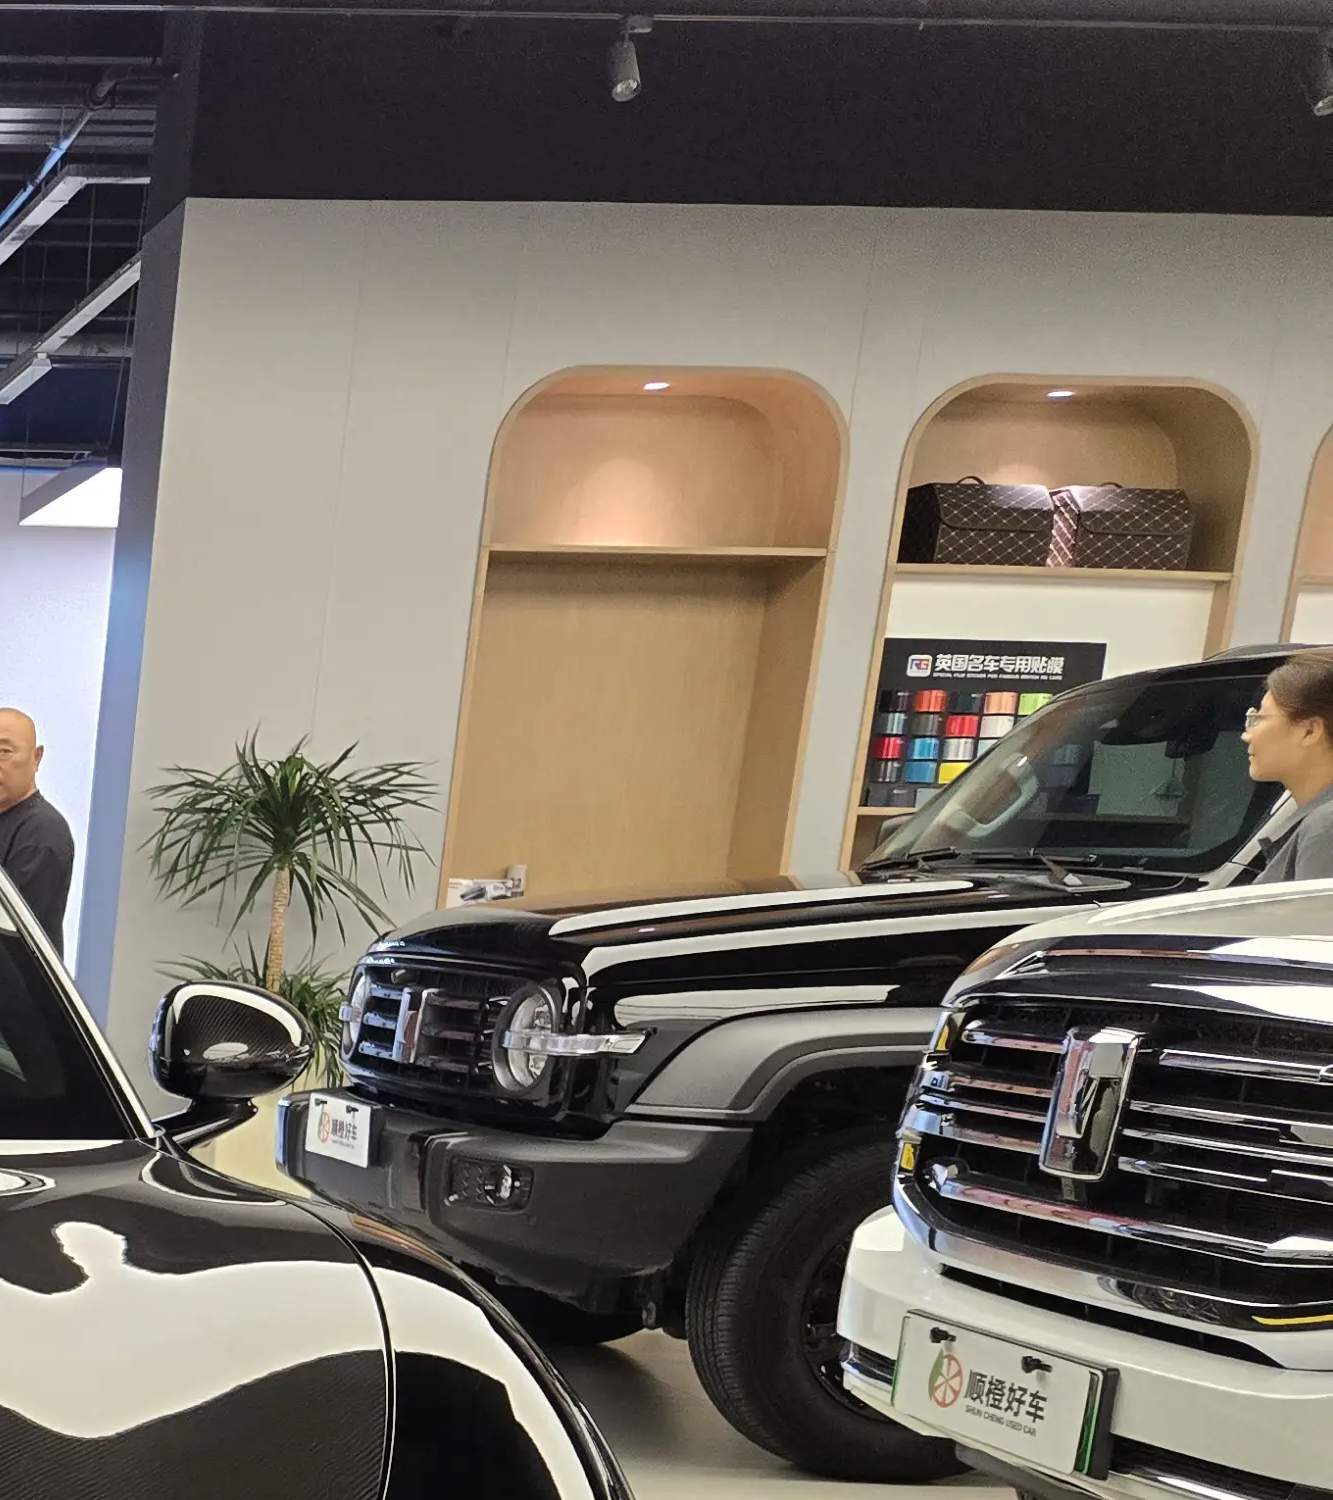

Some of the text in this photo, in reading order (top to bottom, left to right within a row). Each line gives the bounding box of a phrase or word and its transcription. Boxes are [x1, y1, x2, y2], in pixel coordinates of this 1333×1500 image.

[934, 653, 1065, 675] 英国名车专用贴膜
[963, 1369, 1048, 1424] 顺橙好车
